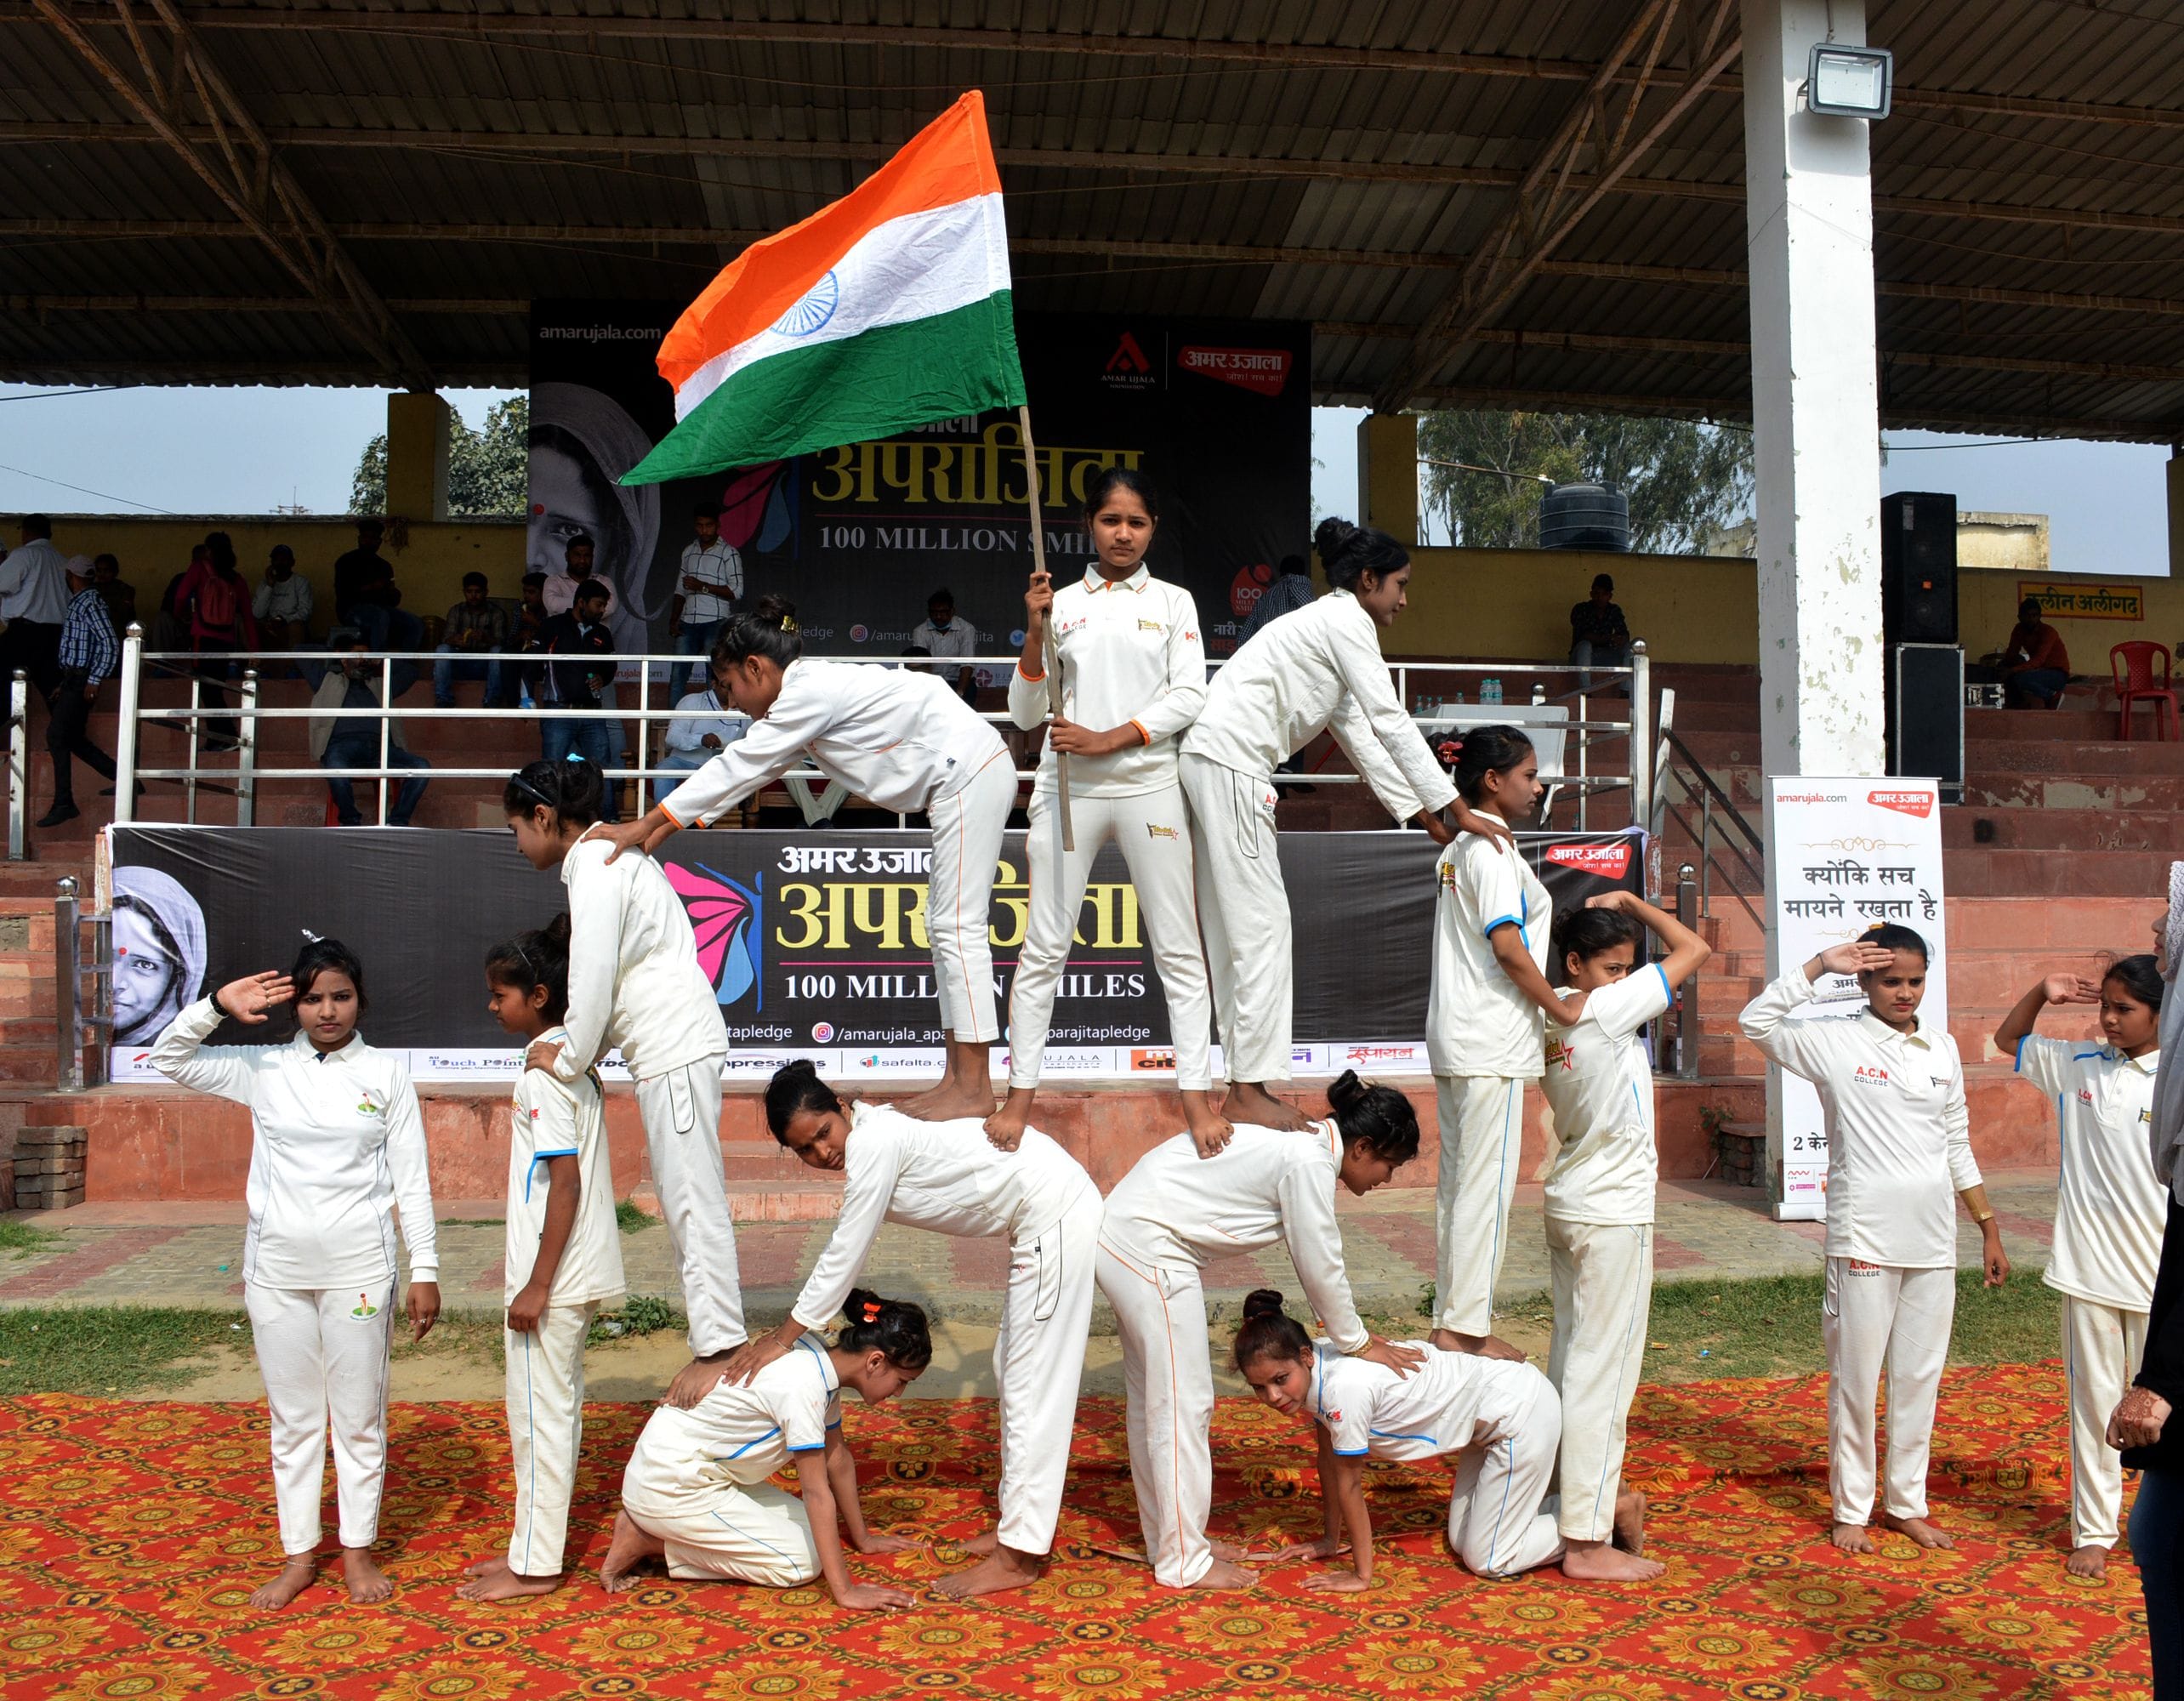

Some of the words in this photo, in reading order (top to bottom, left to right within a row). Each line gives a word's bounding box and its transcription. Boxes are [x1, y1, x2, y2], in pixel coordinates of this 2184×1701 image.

[538, 322, 662, 344] amarujala.com
[1184, 350, 1227, 367] अमर
[1228, 353, 1283, 371] उजाला
[819, 526, 866, 549] 100
[875, 526, 1017, 552] MILLION
[1237, 588, 1263, 600] 100
[1776, 793, 1847, 805] amarujala.com
[1872, 793, 1897, 804] अमर
[1897, 794, 1929, 804] उजाला
[776, 845, 857, 874] अमर
[1551, 848, 1584, 860] अमर
[1584, 848, 1624, 860] उजाला
[1802, 859, 1870, 885] क्योंकि
[1877, 868, 1916, 885] सच
[1783, 893, 1846, 919] मायने
[1853, 900, 1914, 919] रखता
[1918, 889, 1938, 920] है
[784, 975, 836, 999] 100
[845, 975, 1003, 999] MILLN
[836, 1027, 947, 1044] /amarujala_apa
[1046, 1024, 1151, 1042] parajitapledge
[881, 1059, 947, 1067] safalta.c
[1138, 1057, 1176, 1068] cit
[1854, 1075, 1889, 1087] COLLEGE
[1856, 1066, 1888, 1080] A.C.N
[1793, 1136, 1804, 1151] 2
